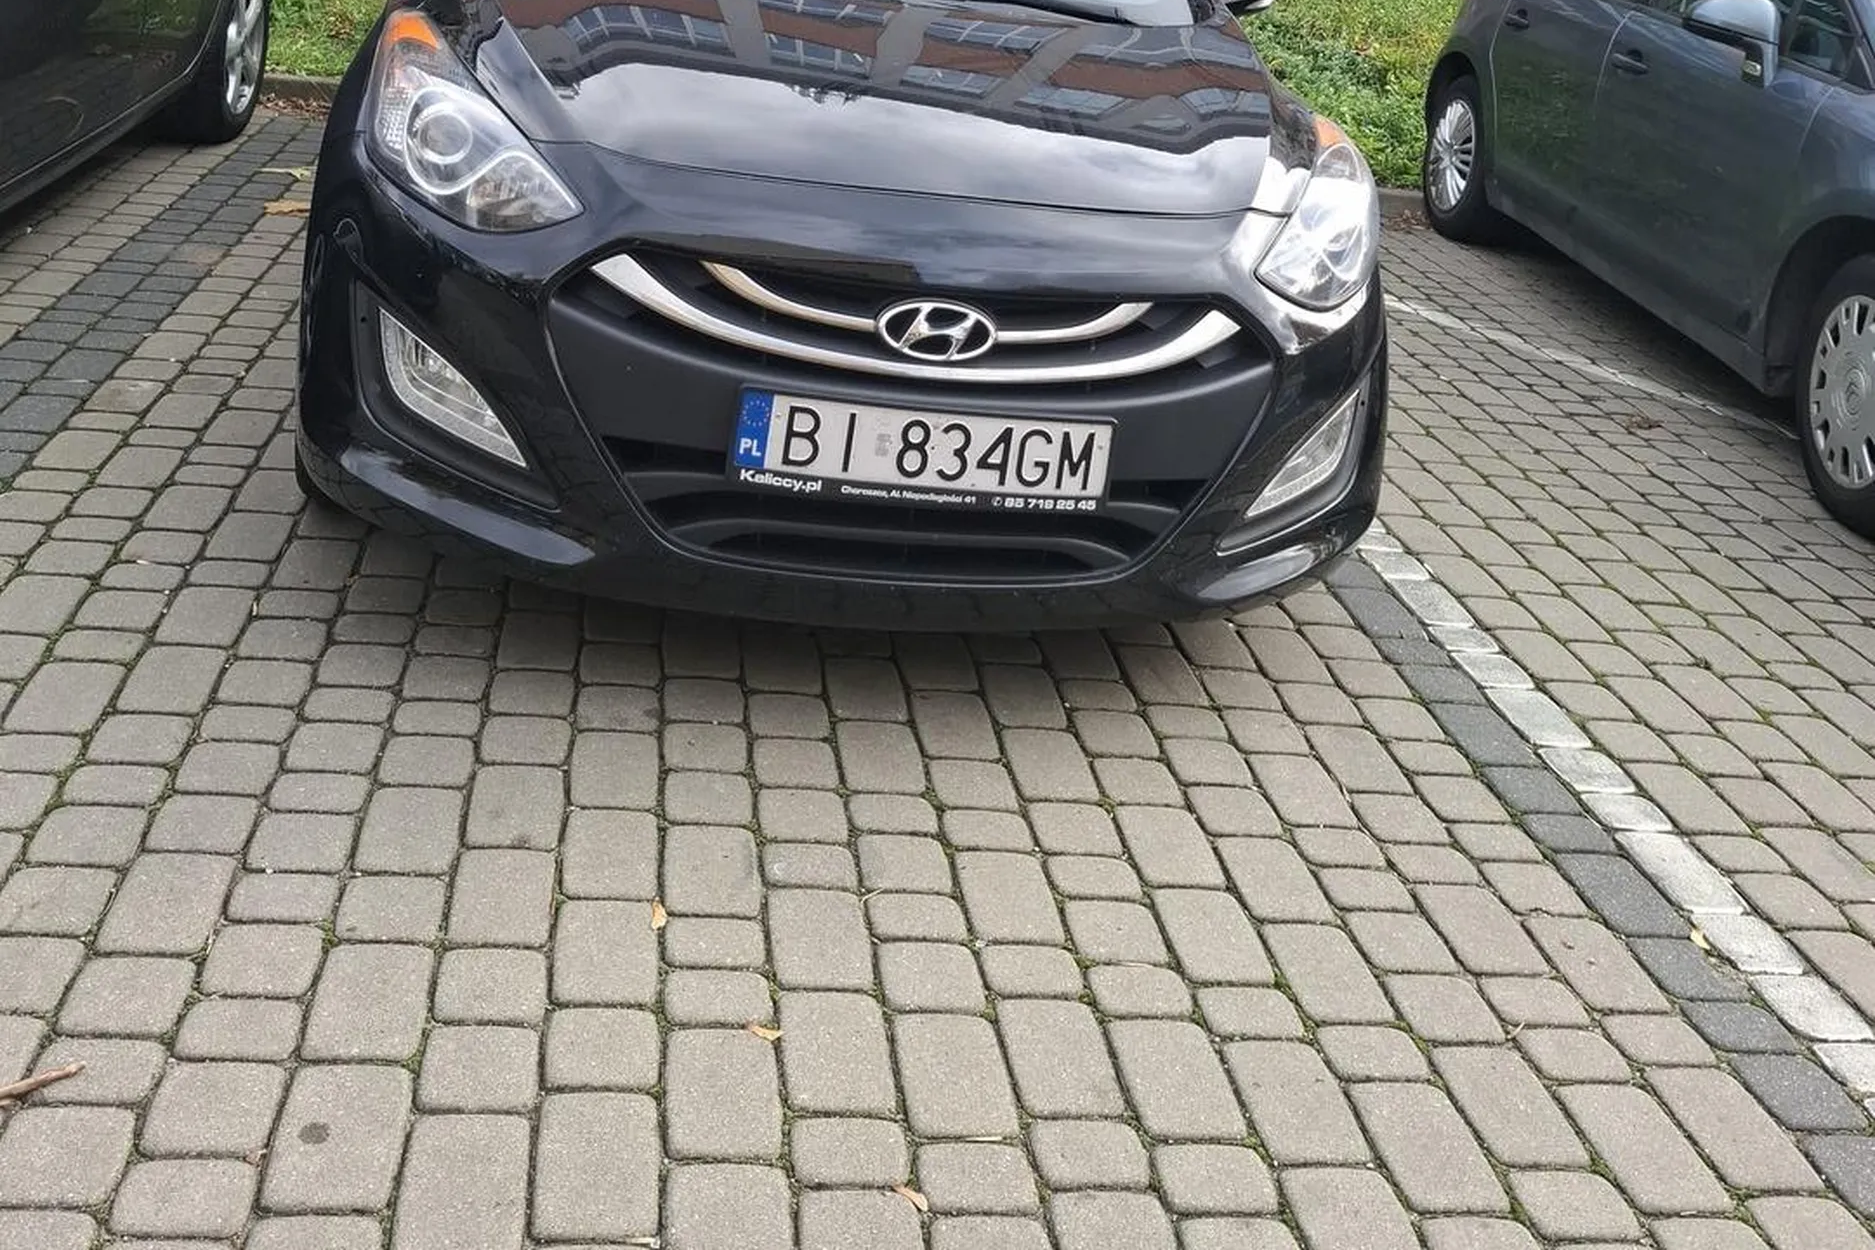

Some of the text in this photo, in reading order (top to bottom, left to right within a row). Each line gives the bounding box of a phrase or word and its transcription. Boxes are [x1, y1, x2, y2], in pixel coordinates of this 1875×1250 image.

[739, 437, 762, 457] PL
[896, 419, 1095, 491] 834GM
[1077, 499, 1097, 510] 45
